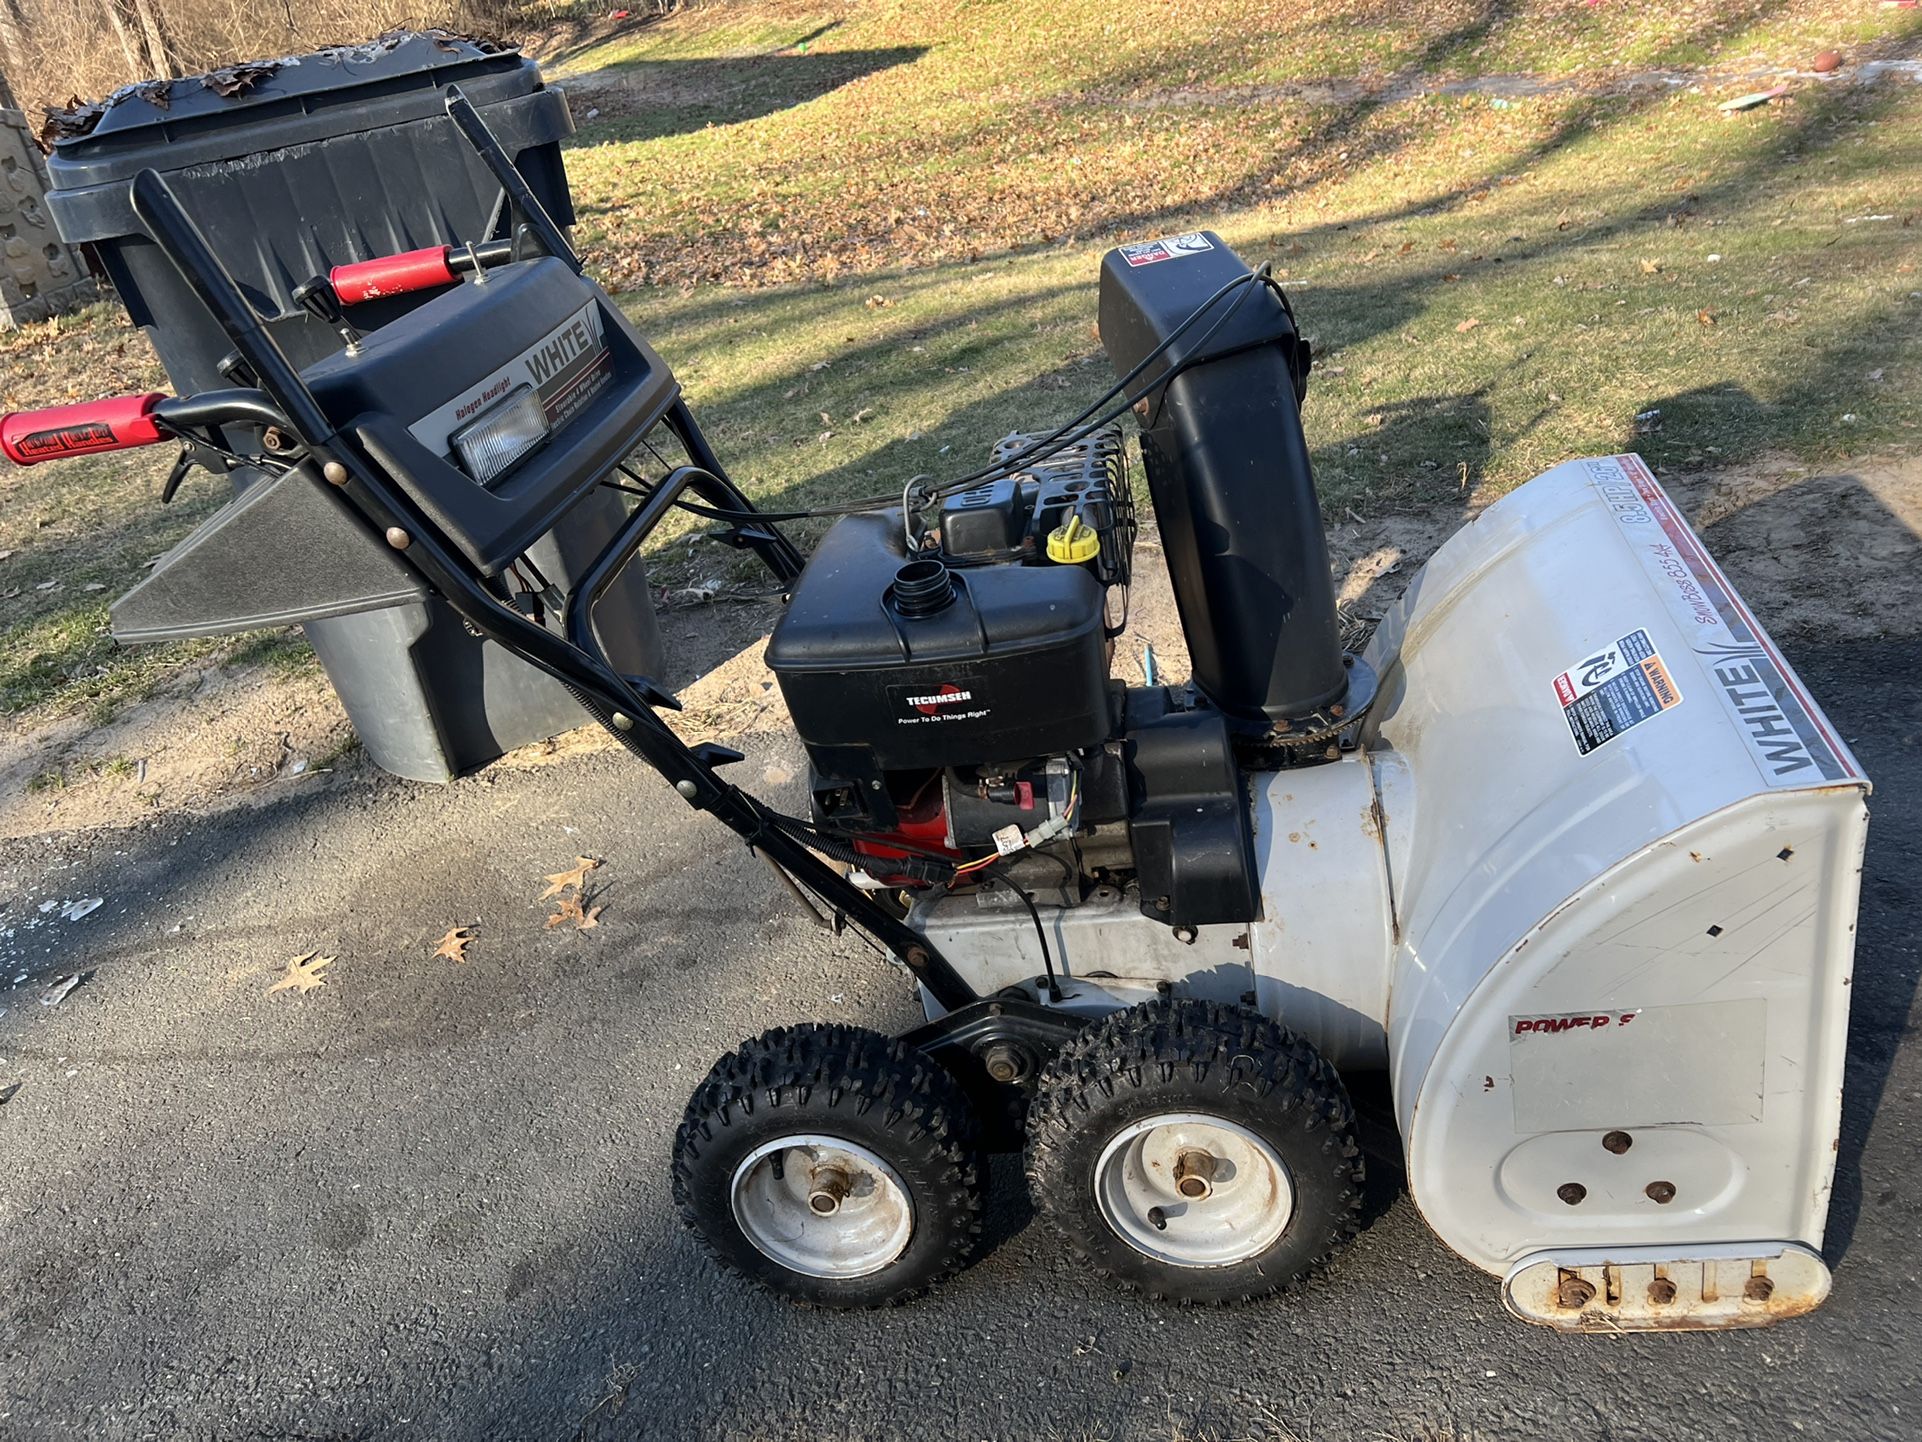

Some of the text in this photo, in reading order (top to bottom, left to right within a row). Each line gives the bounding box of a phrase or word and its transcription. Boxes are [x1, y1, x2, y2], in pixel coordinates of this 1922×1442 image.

[525, 320, 590, 385] WHITE
[456, 376, 511, 422] Halogen Headlight
[19, 427, 114, 456] Heated Handles
[1602, 486, 1639, 502] HP
[1613, 503, 1652, 524] 8.5
[1659, 559, 1687, 578] 855
[906, 691, 972, 706] TECUMSEH
[1648, 667, 1674, 704] WARNING
[1714, 664, 1813, 776] WHITE
